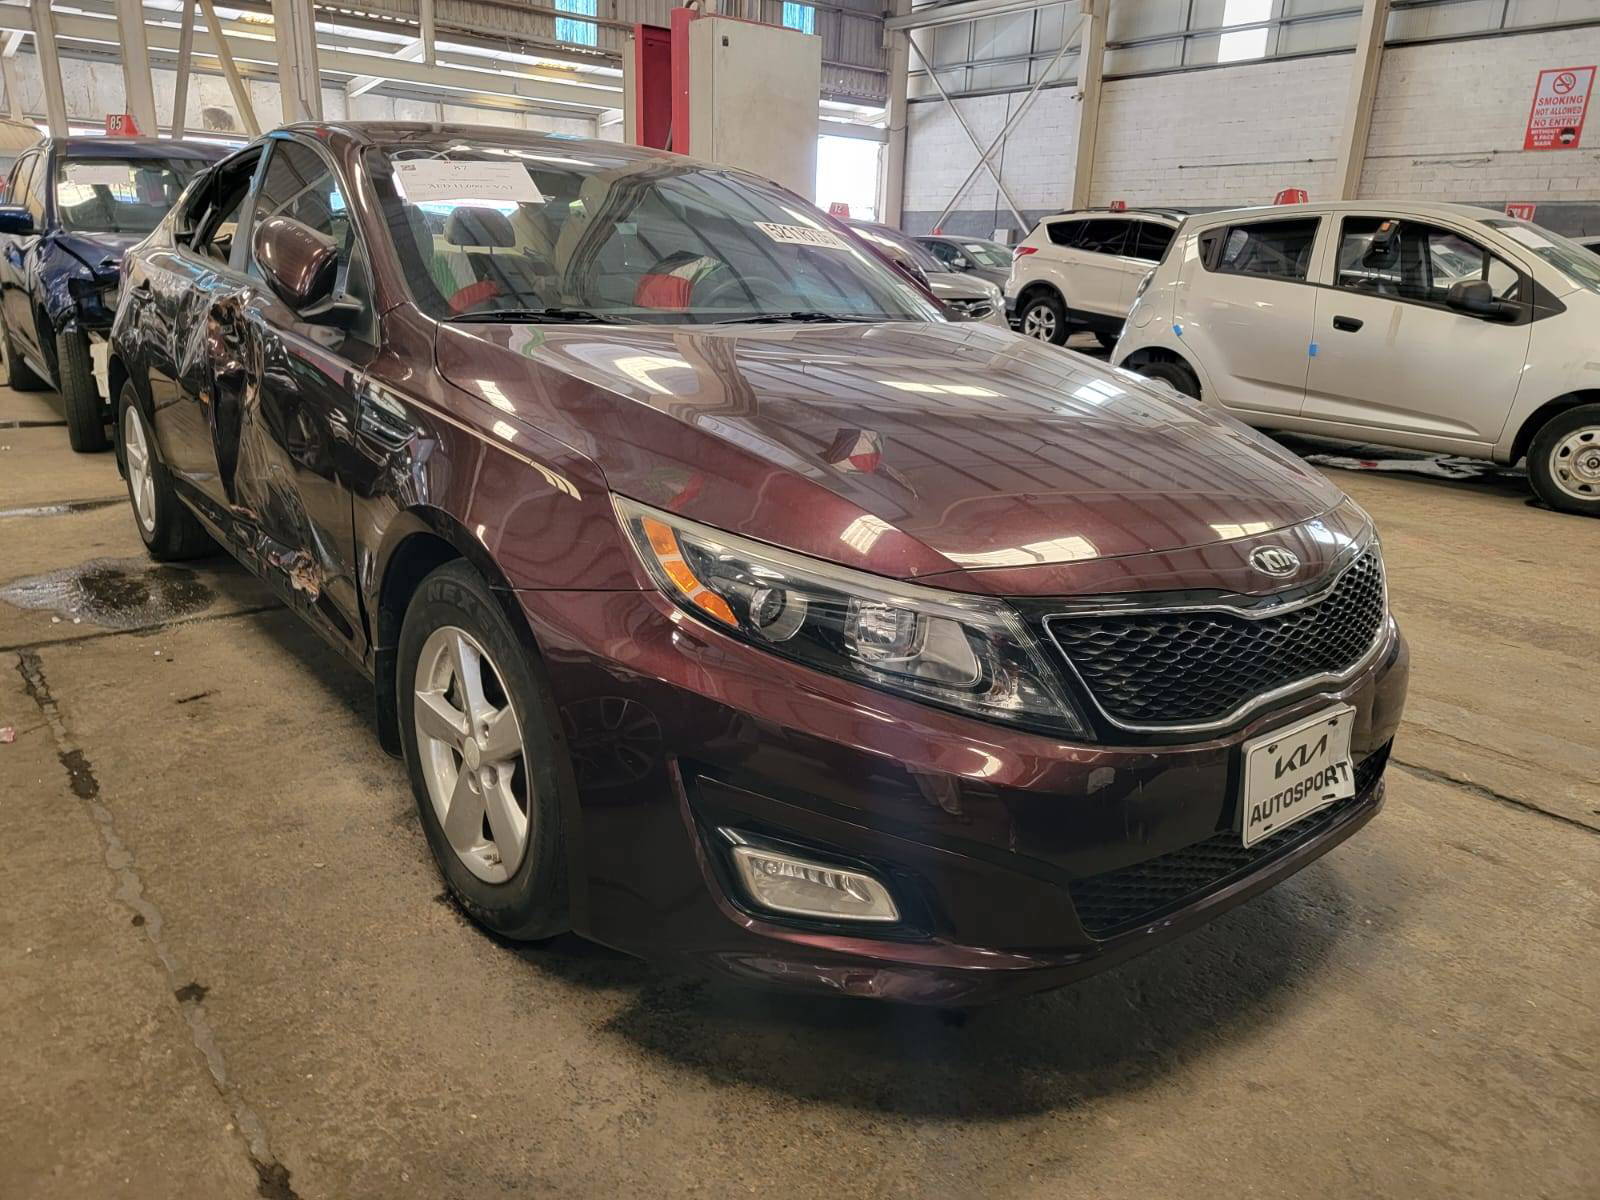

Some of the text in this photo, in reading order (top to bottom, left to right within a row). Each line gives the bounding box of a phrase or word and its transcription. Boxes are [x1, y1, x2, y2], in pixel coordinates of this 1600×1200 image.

[1538, 96, 1583, 106] SMOKING
[1535, 106, 1582, 116] NOT ALLOWED
[110, 115, 122, 130] 85
[1534, 118, 1578, 127] NO ENTRY
[1255, 548, 1296, 571] KIA
[1249, 761, 1350, 828] AUTOSPORT
